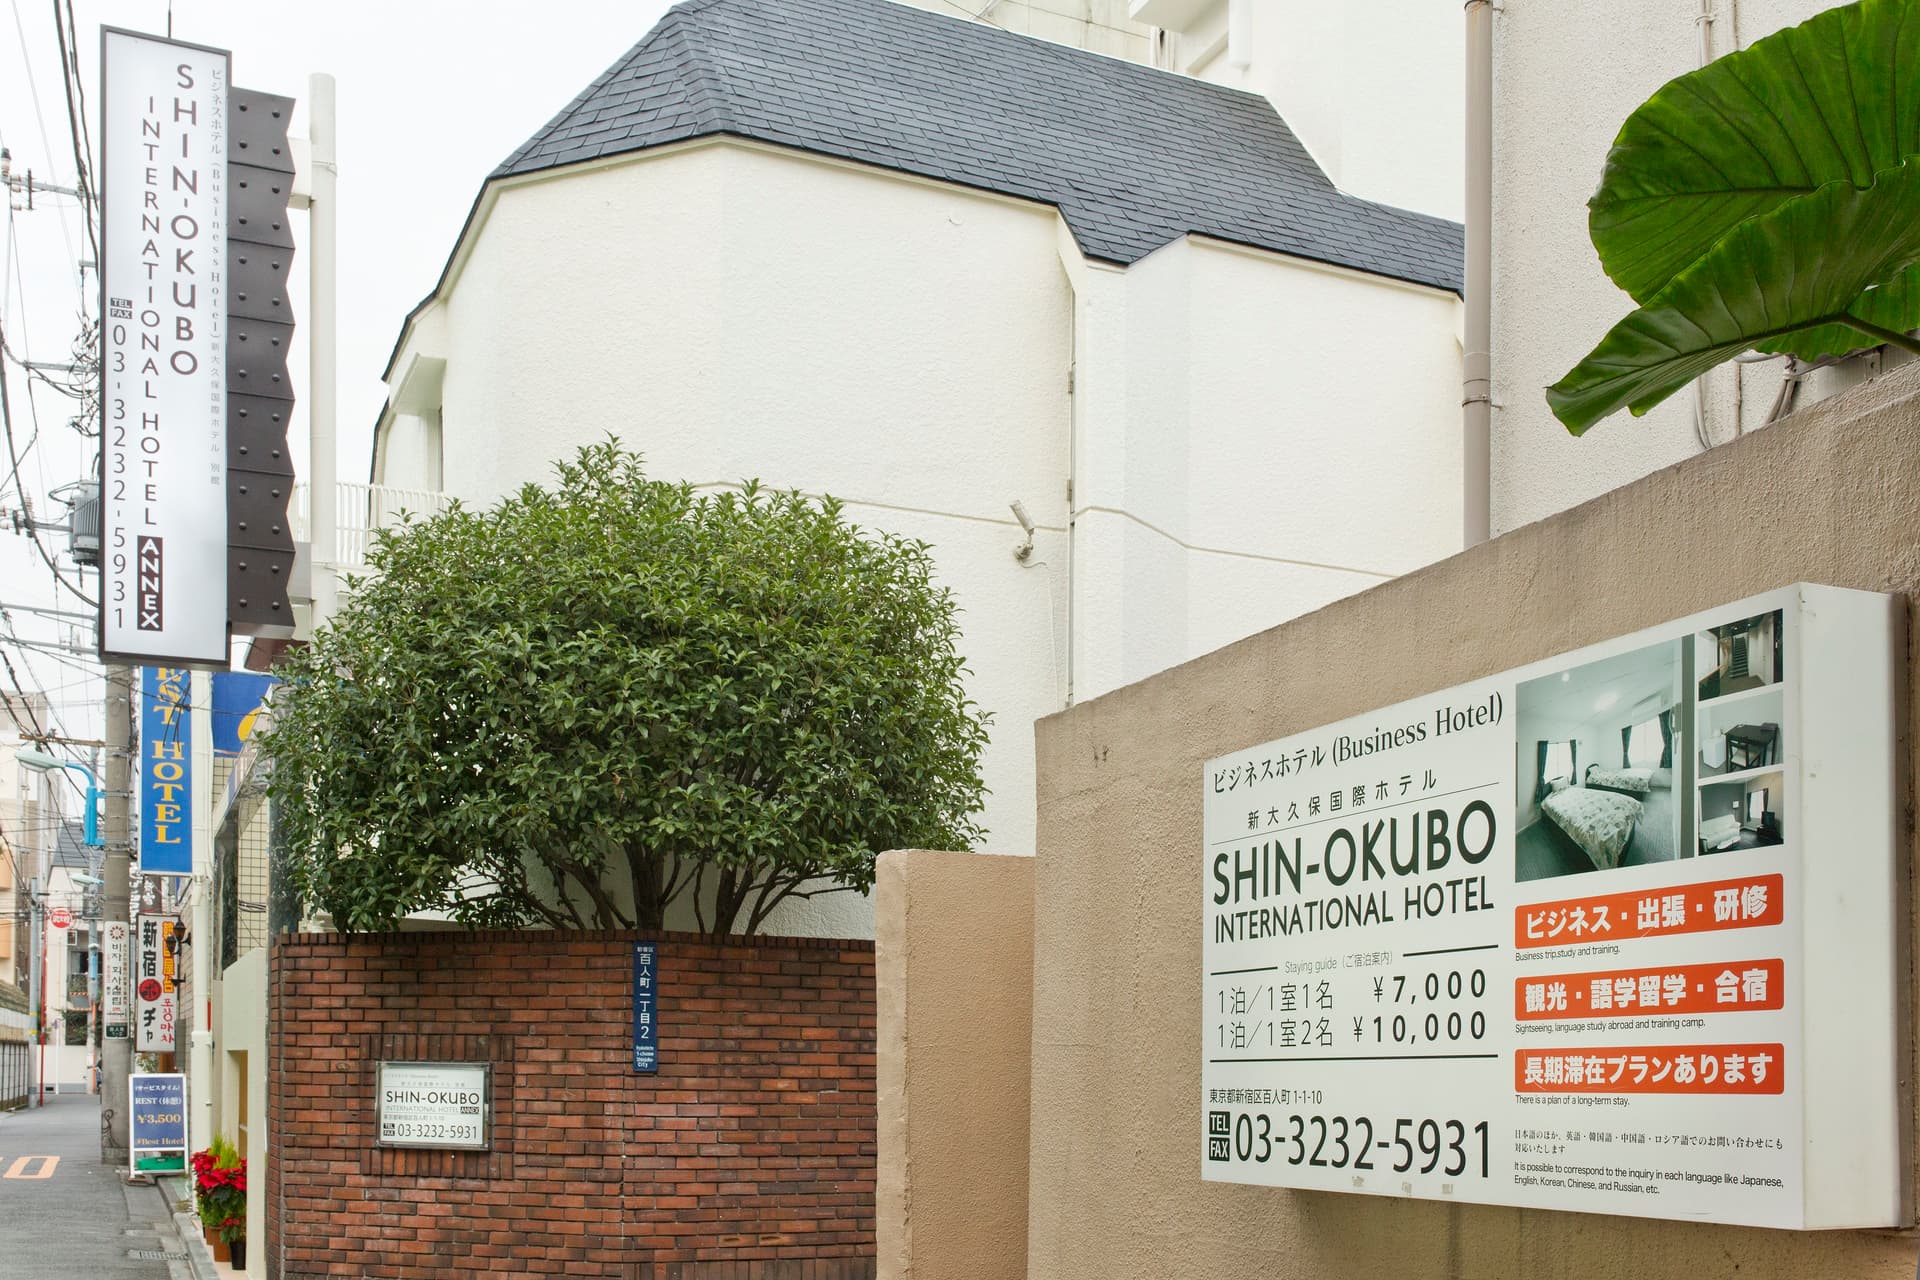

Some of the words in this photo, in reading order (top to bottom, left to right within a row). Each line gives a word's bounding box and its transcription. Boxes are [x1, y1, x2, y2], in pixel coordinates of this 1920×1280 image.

[170, 64, 198, 375] SHIN-OKUBO
[140, 96, 160, 399] INTERNATIONAL
[111, 299, 131, 308] TEL
[111, 309, 132, 319] FAX
[113, 325, 127, 628] 03-3232-5931
[140, 412, 160, 525] HOTEL
[141, 538, 160, 628] ANNEX
[1213, 746, 1327, 793] ビジネスホテル
[1332, 721, 1426, 767] (Business
[1435, 691, 1503, 736] Hotel)
[152, 740, 185, 844] HOTEL
[1247, 769, 1437, 830] 新大久保国際ホテル
[1213, 799, 1496, 905] SHIN-OKUBO
[1215, 890, 1394, 944] INTERNATIONAL
[1404, 875, 1494, 920] HOTEL
[1516, 951, 1544, 961] Business
[1577, 946, 1591, 956] and
[1285, 960, 1313, 975] Staying
[1315, 958, 1337, 974] guide
[1555, 1023, 1586, 1033] language
[1587, 1021, 1606, 1032] study
[1608, 1020, 1634, 1030] abroad
[1635, 1019, 1649, 1029] and
[1651, 1018, 1680, 1030] training
[1524, 1052, 1773, 1085] 長期滞在プランあります
[135, 1097, 158, 1105] REST
[386, 1091, 479, 1105] SHIN-OKUBO
[1209, 1087, 1291, 1105] 東京都新宿区百人町
[1293, 1089, 1322, 1105] 1-1-10
[1515, 1094, 1534, 1104] There
[1535, 1096, 1540, 1104] is
[1547, 1096, 1561, 1106] plan
[1563, 1096, 1570, 1104] of
[1572, 1097, 1576, 1105] a
[1577, 1096, 1611, 1107] long-term
[1613, 1097, 1630, 1107] stay.
[398, 1123, 477, 1139] 03-3232-5931
[1210, 1114, 1230, 1132] TEL
[1210, 1139, 1230, 1158] FAX
[1235, 1112, 1489, 1178] 03-3232-5931
[1514, 1161, 1519, 1170] It
[1520, 1162, 1525, 1171] is
[1527, 1162, 1554, 1173] possible
[1555, 1164, 1562, 1173] to
[1563, 1166, 1604, 1177] correspond
[1606, 1168, 1613, 1177] to
[1615, 1168, 1627, 1177] the
[1628, 1168, 1654, 1180] inquiry
[1655, 1170, 1663, 1179] in
[1664, 1171, 1683, 1181] each
[1685, 1171, 1722, 1185] language
[1724, 1173, 1739, 1184] like
[1740, 1174, 1784, 1188] Japanese,
[1567, 1178, 1597, 1190] Chinese,
[1598, 1181, 1612, 1191] and
[1646, 1185, 1660, 1194] etc.
